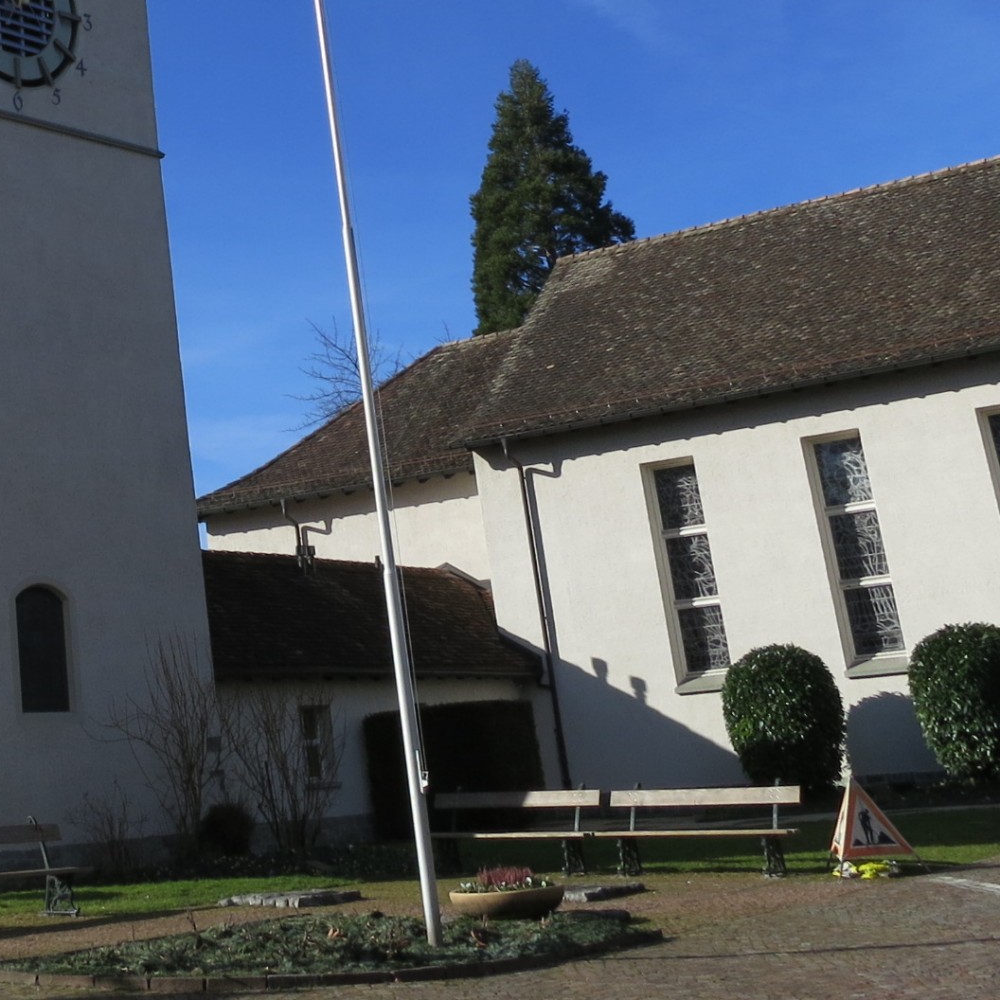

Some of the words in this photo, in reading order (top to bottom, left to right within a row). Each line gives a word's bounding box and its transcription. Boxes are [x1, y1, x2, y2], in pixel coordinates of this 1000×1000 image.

[83, 14, 93, 30] 3
[76, 59, 86, 76] 4
[13, 92, 23, 111] 6
[52, 89, 61, 105] 5
